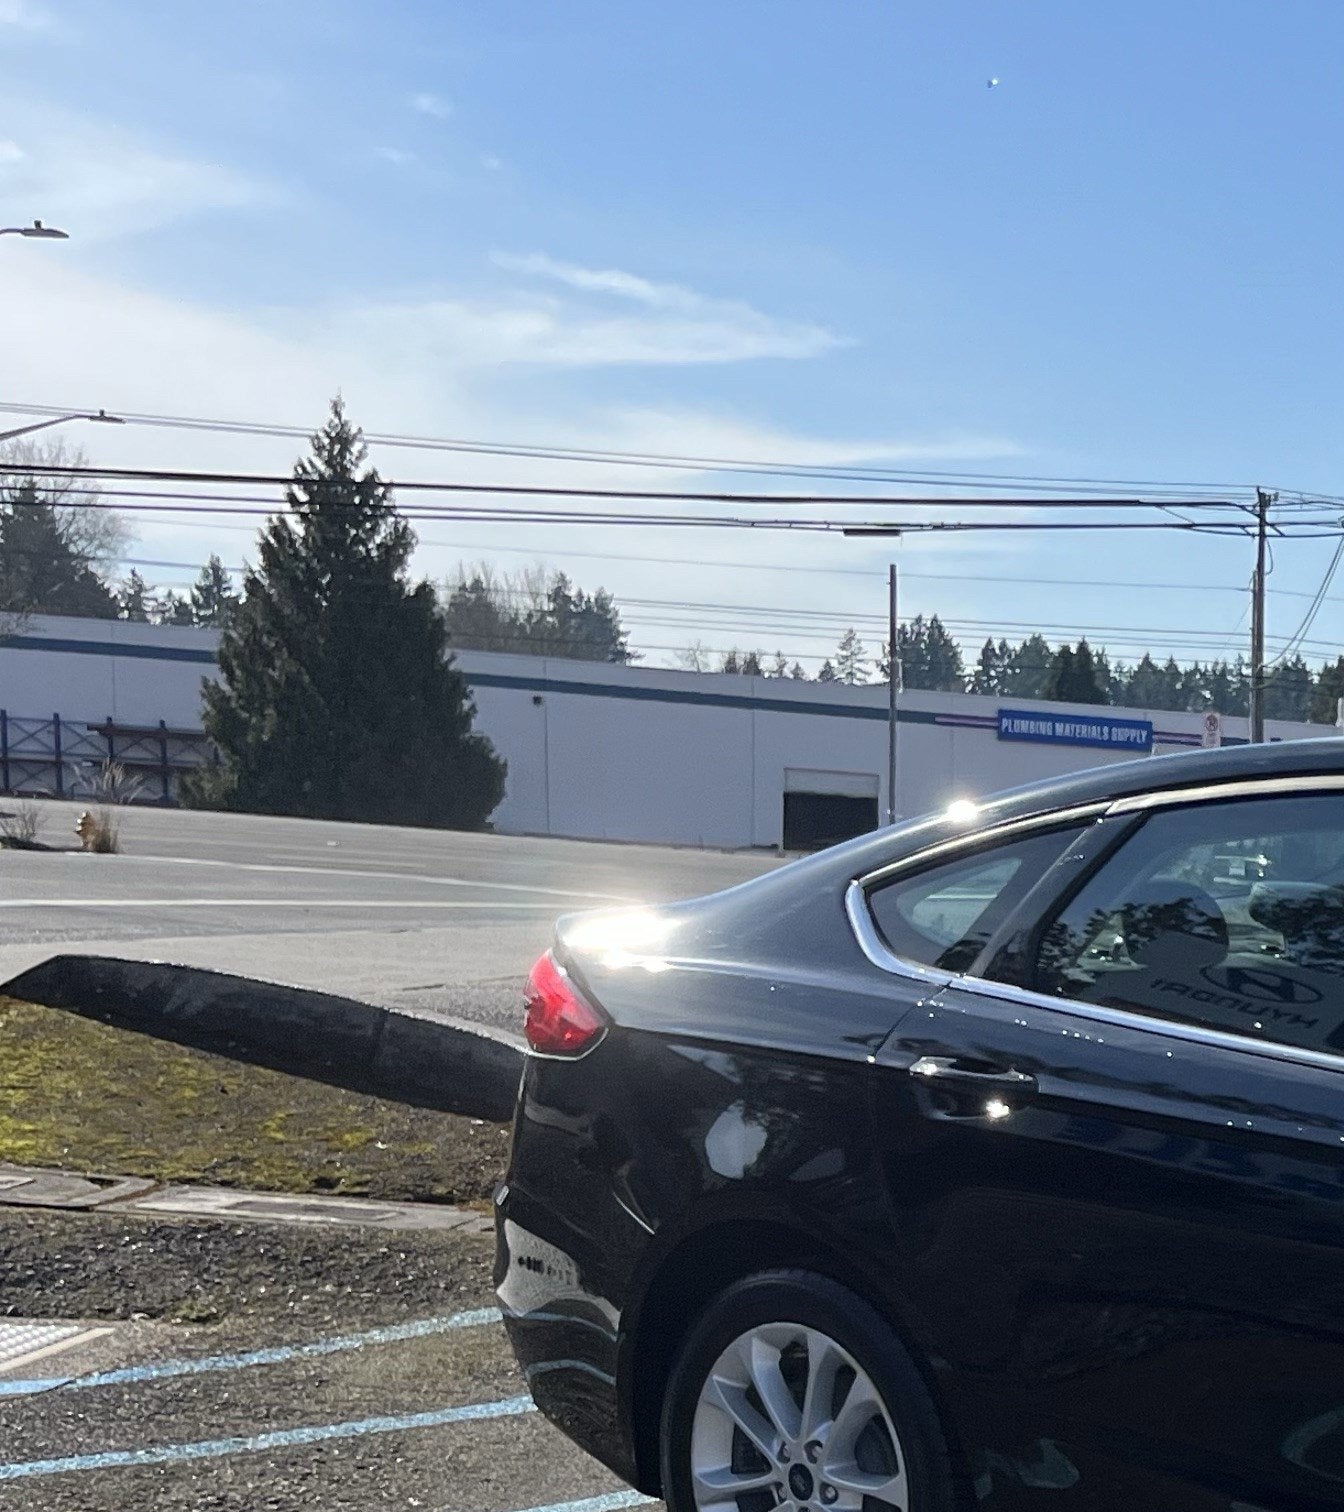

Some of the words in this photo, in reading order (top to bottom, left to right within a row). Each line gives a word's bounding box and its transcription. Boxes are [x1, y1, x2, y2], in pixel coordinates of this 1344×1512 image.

[1002, 717, 1053, 736] PLUMBING
[1054, 722, 1109, 741] MATERIALS
[1110, 726, 1148, 744] SUPPLY
